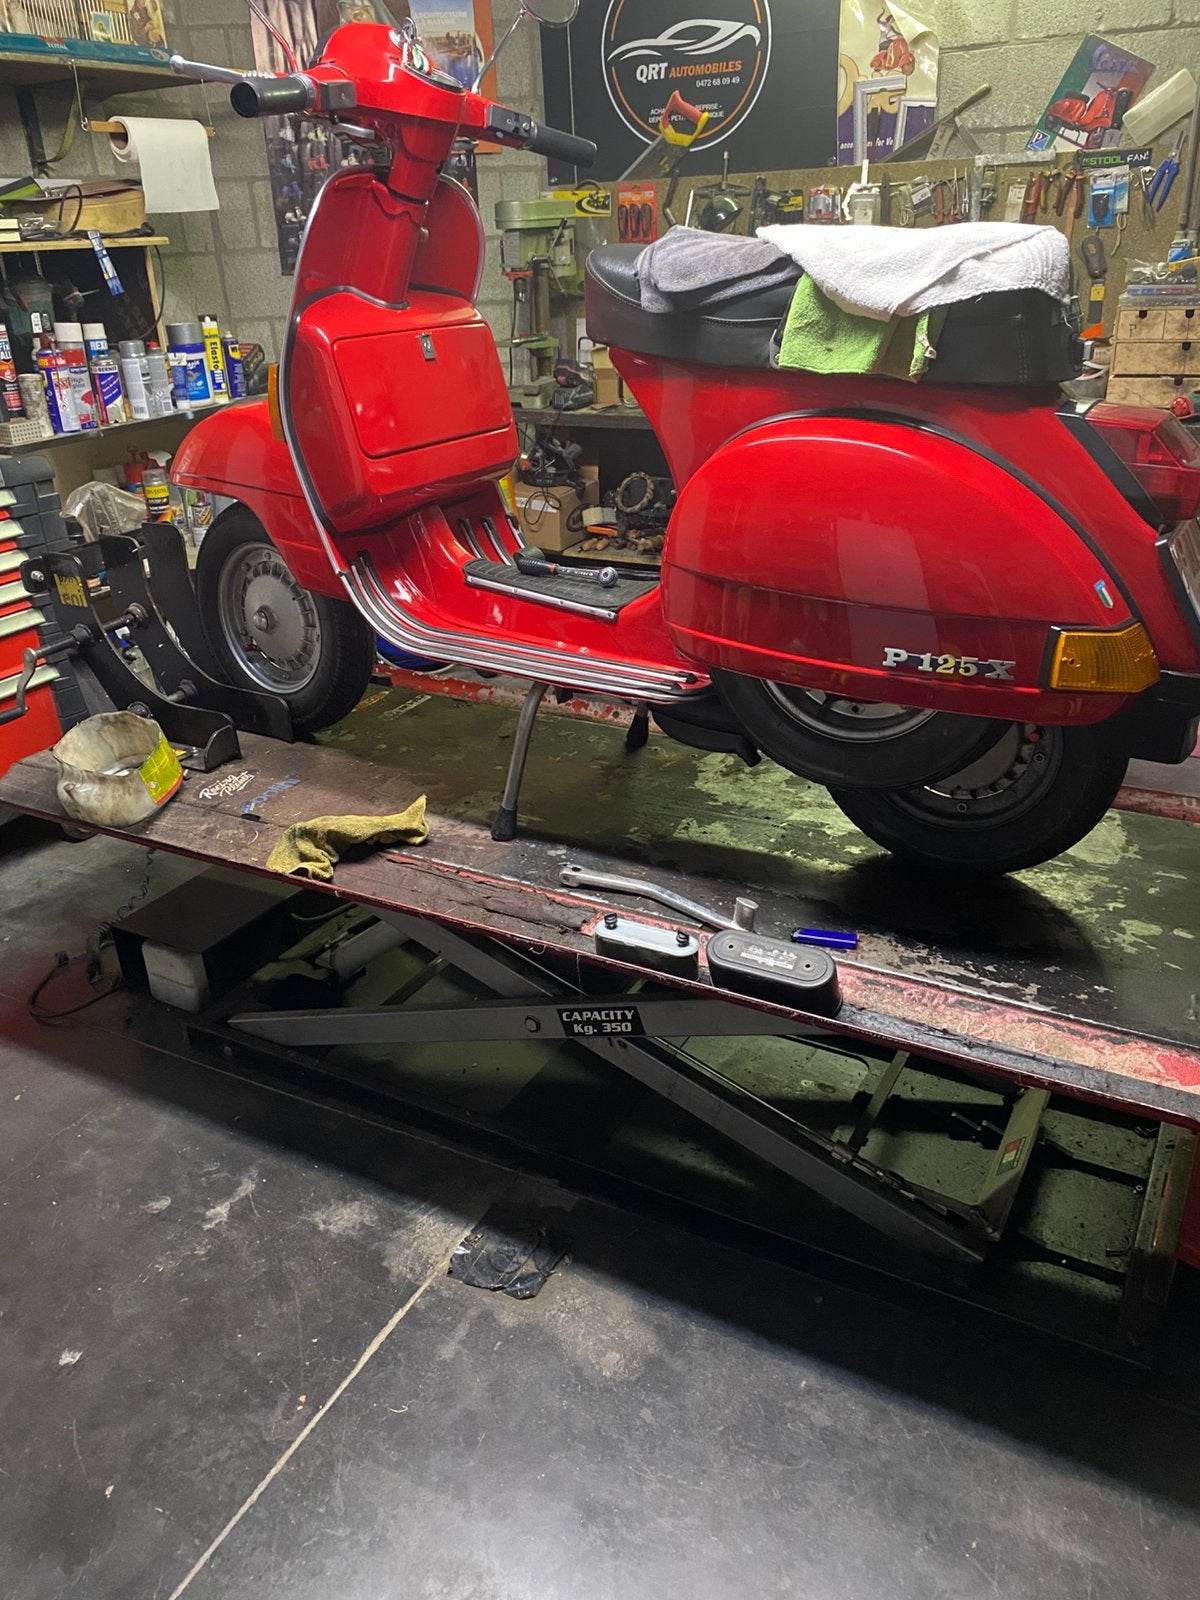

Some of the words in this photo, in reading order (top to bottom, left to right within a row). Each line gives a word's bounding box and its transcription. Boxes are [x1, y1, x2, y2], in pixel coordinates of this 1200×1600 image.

[636, 62, 668, 84] QRT
[669, 60, 743, 78] AUTOMOBILES
[695, 78, 712, 88] 0472
[712, 78, 721, 87] 68
[722, 77, 731, 85] 09
[731, 76, 741, 84] 49
[1126, 151, 1149, 163] FAN!
[882, 647, 908, 667] P
[918, 652, 979, 677] 125
[985, 659, 1017, 681] X
[562, 1009, 635, 1022] CAPACITY
[573, 1023, 598, 1035] Kg.
[602, 1022, 632, 1033] 350
